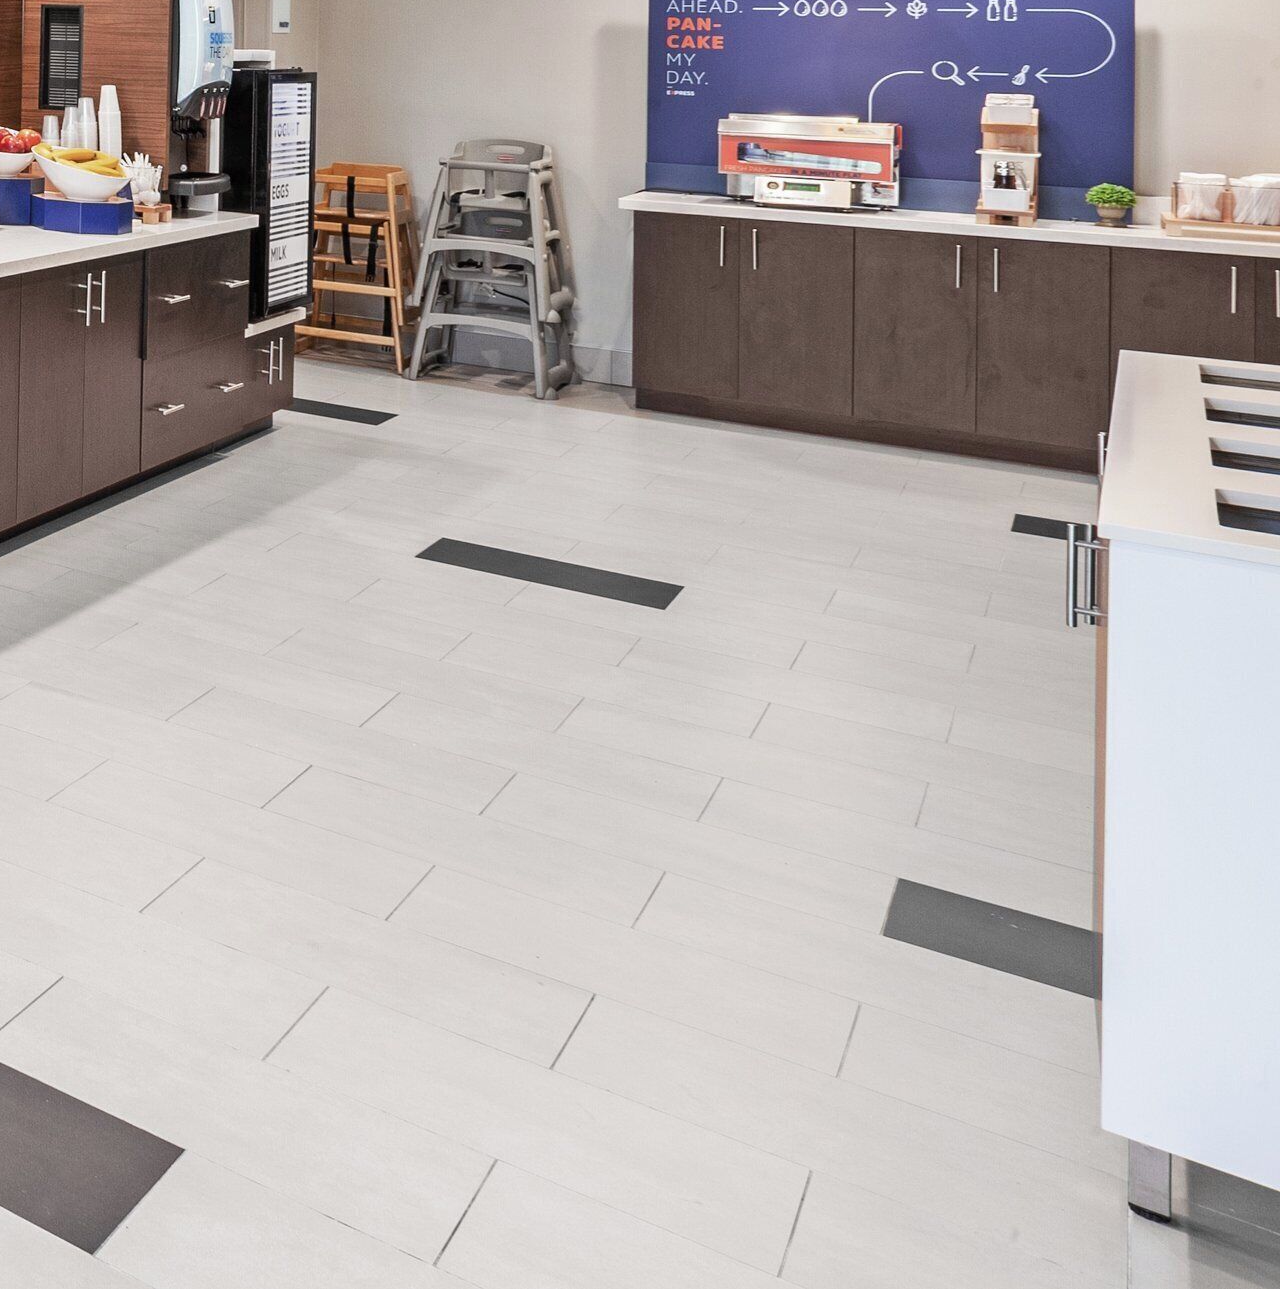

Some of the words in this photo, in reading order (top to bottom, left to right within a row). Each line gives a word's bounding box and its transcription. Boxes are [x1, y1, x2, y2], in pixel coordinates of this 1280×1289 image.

[666, 0, 743, 14] AHEAD.
[667, 17, 722, 31] PAN-
[666, 34, 724, 50] CAKE
[209, 46, 221, 59] THE
[666, 53, 696, 66] MY
[666, 70, 709, 85] DAY.
[724, 164, 746, 172] FRESH
[272, 184, 289, 200] EGGS
[271, 244, 287, 262] MILK
